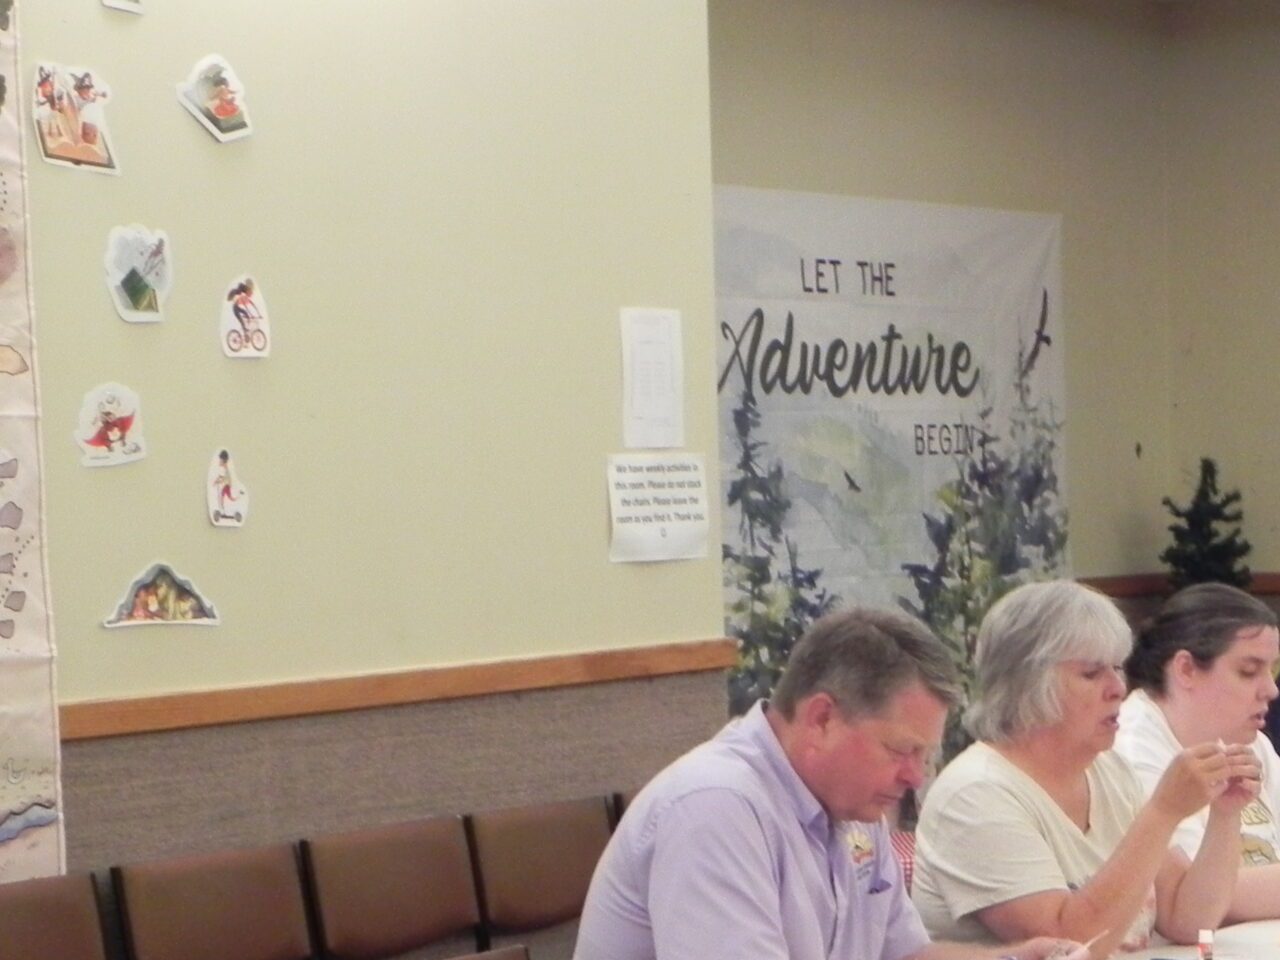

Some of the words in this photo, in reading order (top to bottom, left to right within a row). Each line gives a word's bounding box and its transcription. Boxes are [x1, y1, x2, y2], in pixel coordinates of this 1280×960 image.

[800, 258, 841, 294] LET
[857, 261, 896, 297] THE
[717, 307, 980, 398] Adventure
